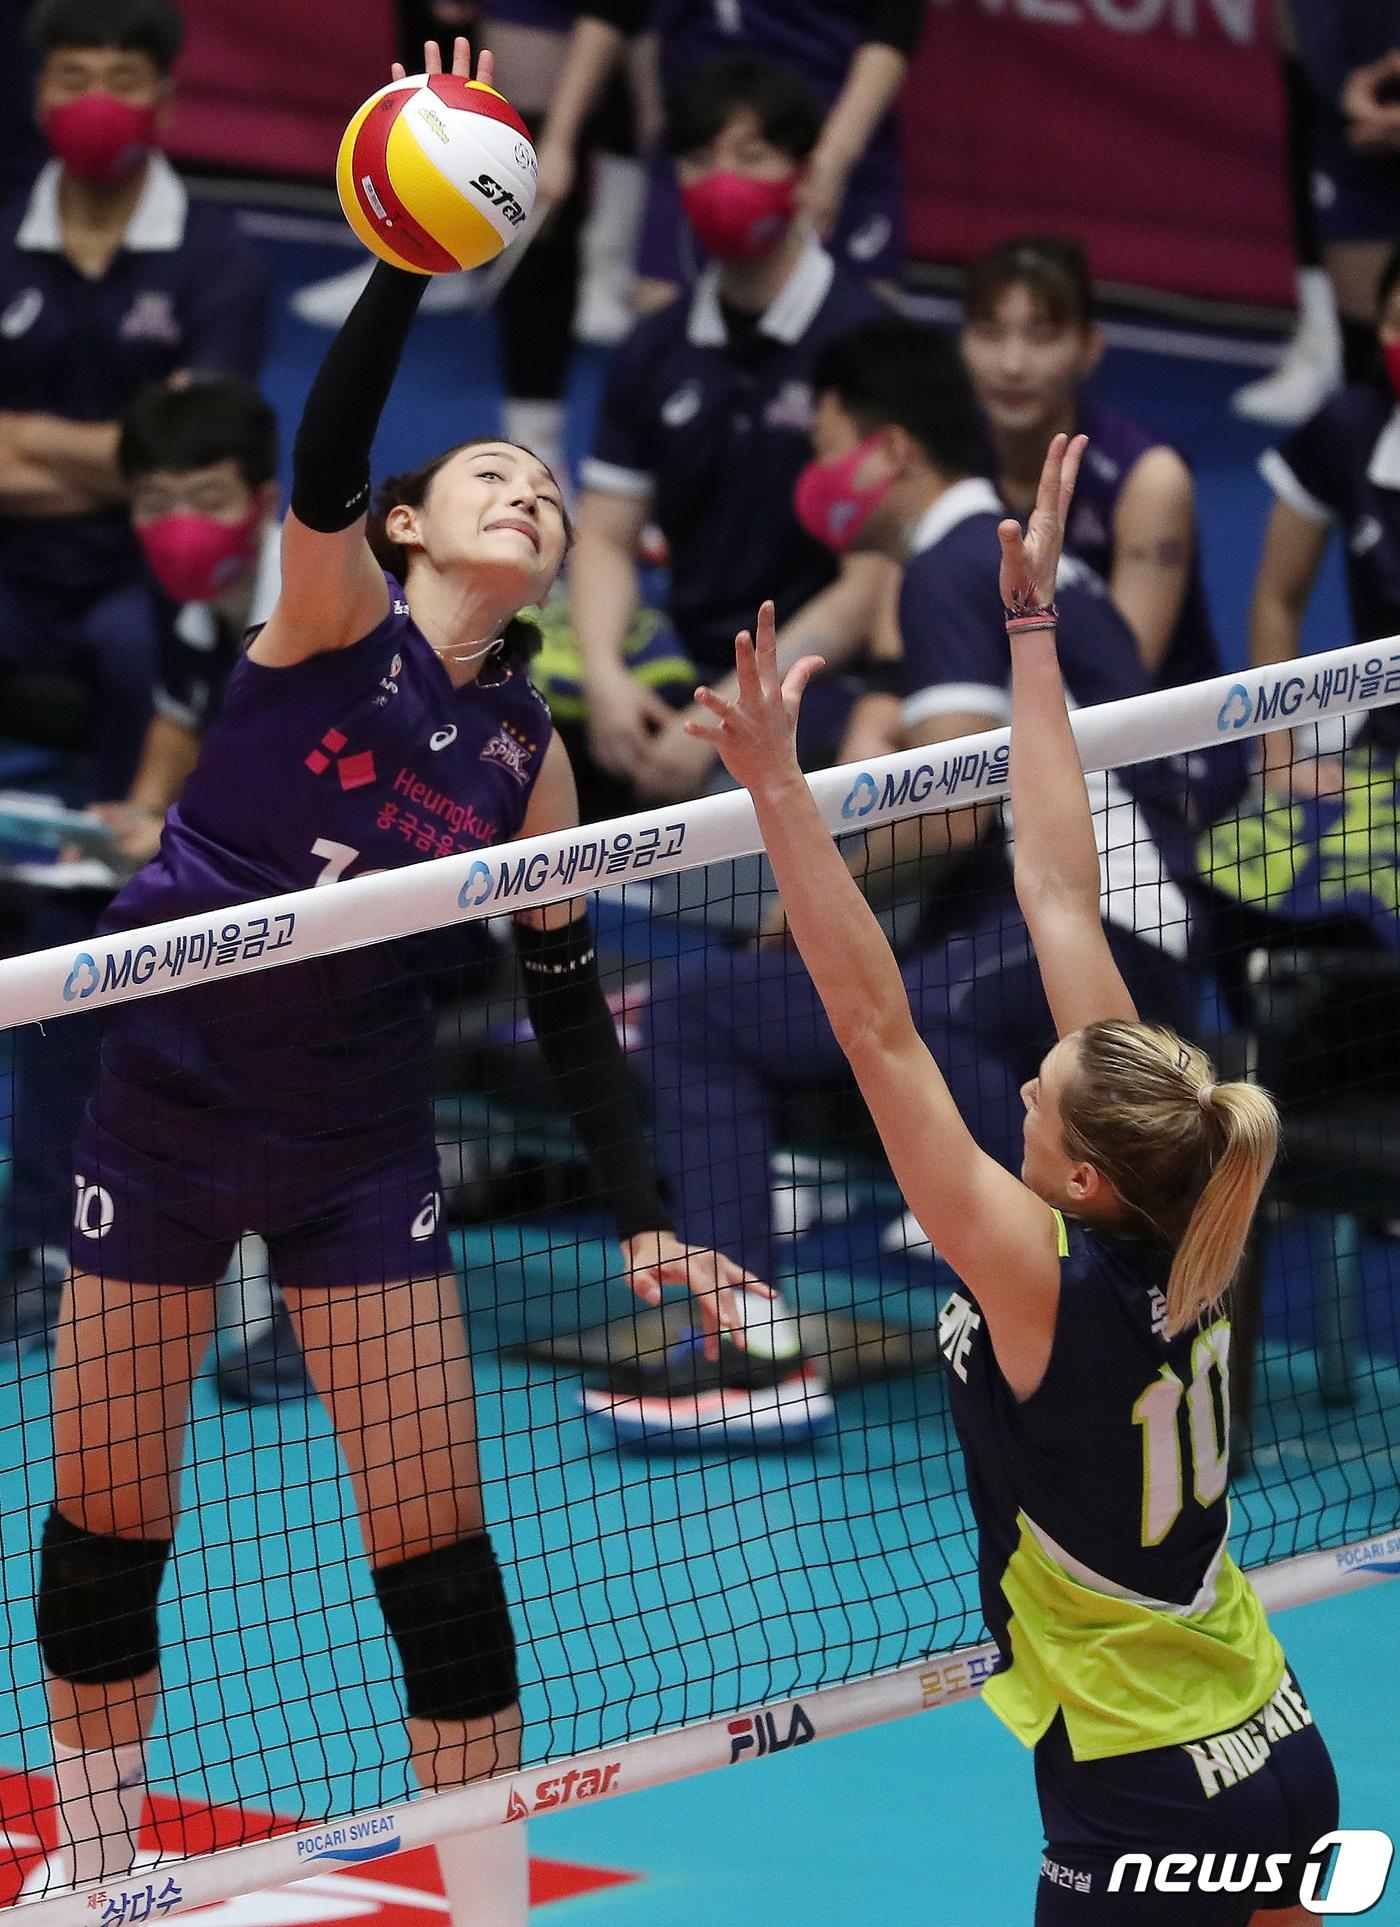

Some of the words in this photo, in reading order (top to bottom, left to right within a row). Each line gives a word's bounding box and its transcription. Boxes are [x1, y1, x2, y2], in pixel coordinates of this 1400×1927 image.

[469, 174, 527, 226] star
[376, 802, 468, 858] 흥국금융
[494, 822, 686, 900] MG새마을금고
[100, 912, 295, 993] MG새마을금고
[1131, 1317, 1232, 1547] 10
[727, 1703, 816, 1764] FILA
[533, 1762, 622, 1811] star
[296, 1829, 347, 1856] POCARI
[349, 1815, 396, 1842] SWEAT
[101, 1877, 182, 1927] 삼다수
